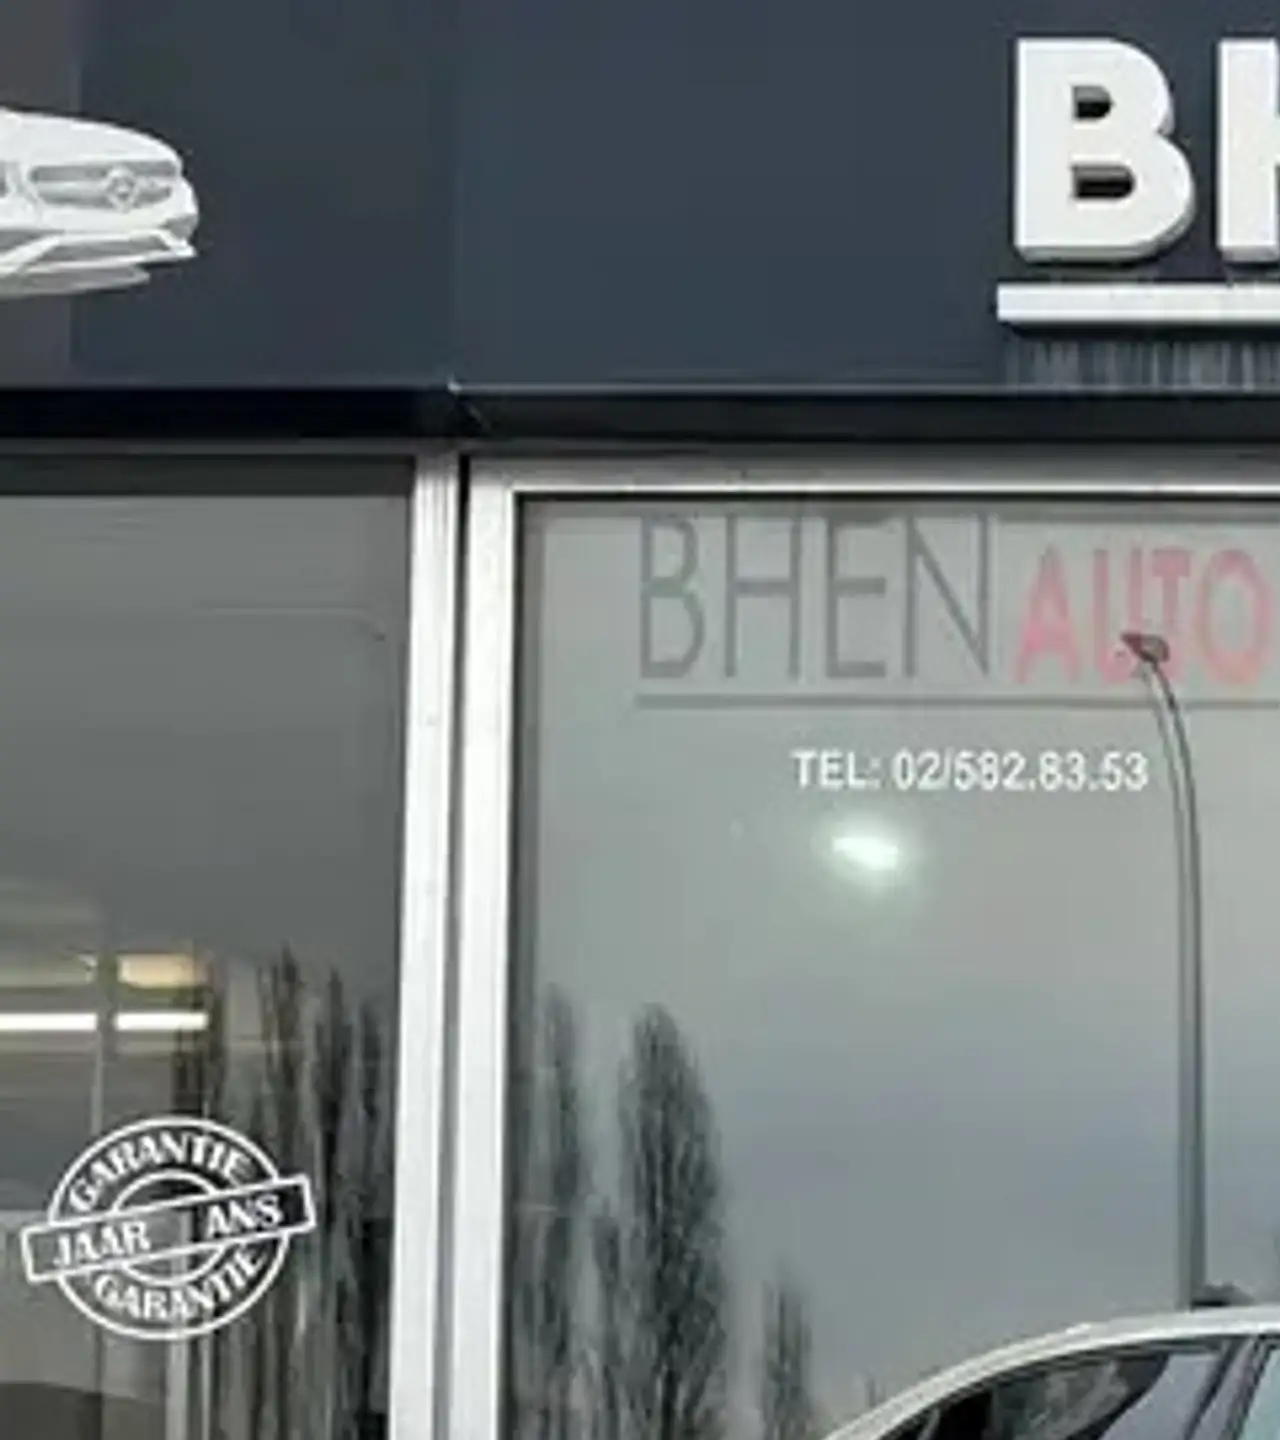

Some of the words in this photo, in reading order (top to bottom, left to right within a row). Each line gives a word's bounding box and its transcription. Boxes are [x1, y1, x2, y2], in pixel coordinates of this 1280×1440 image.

[790, 749, 881, 791] TEL:
[893, 748, 1149, 792] 02/582.83.53
[53, 1221, 151, 1267] JAAR
[206, 1194, 283, 1237] ANS
